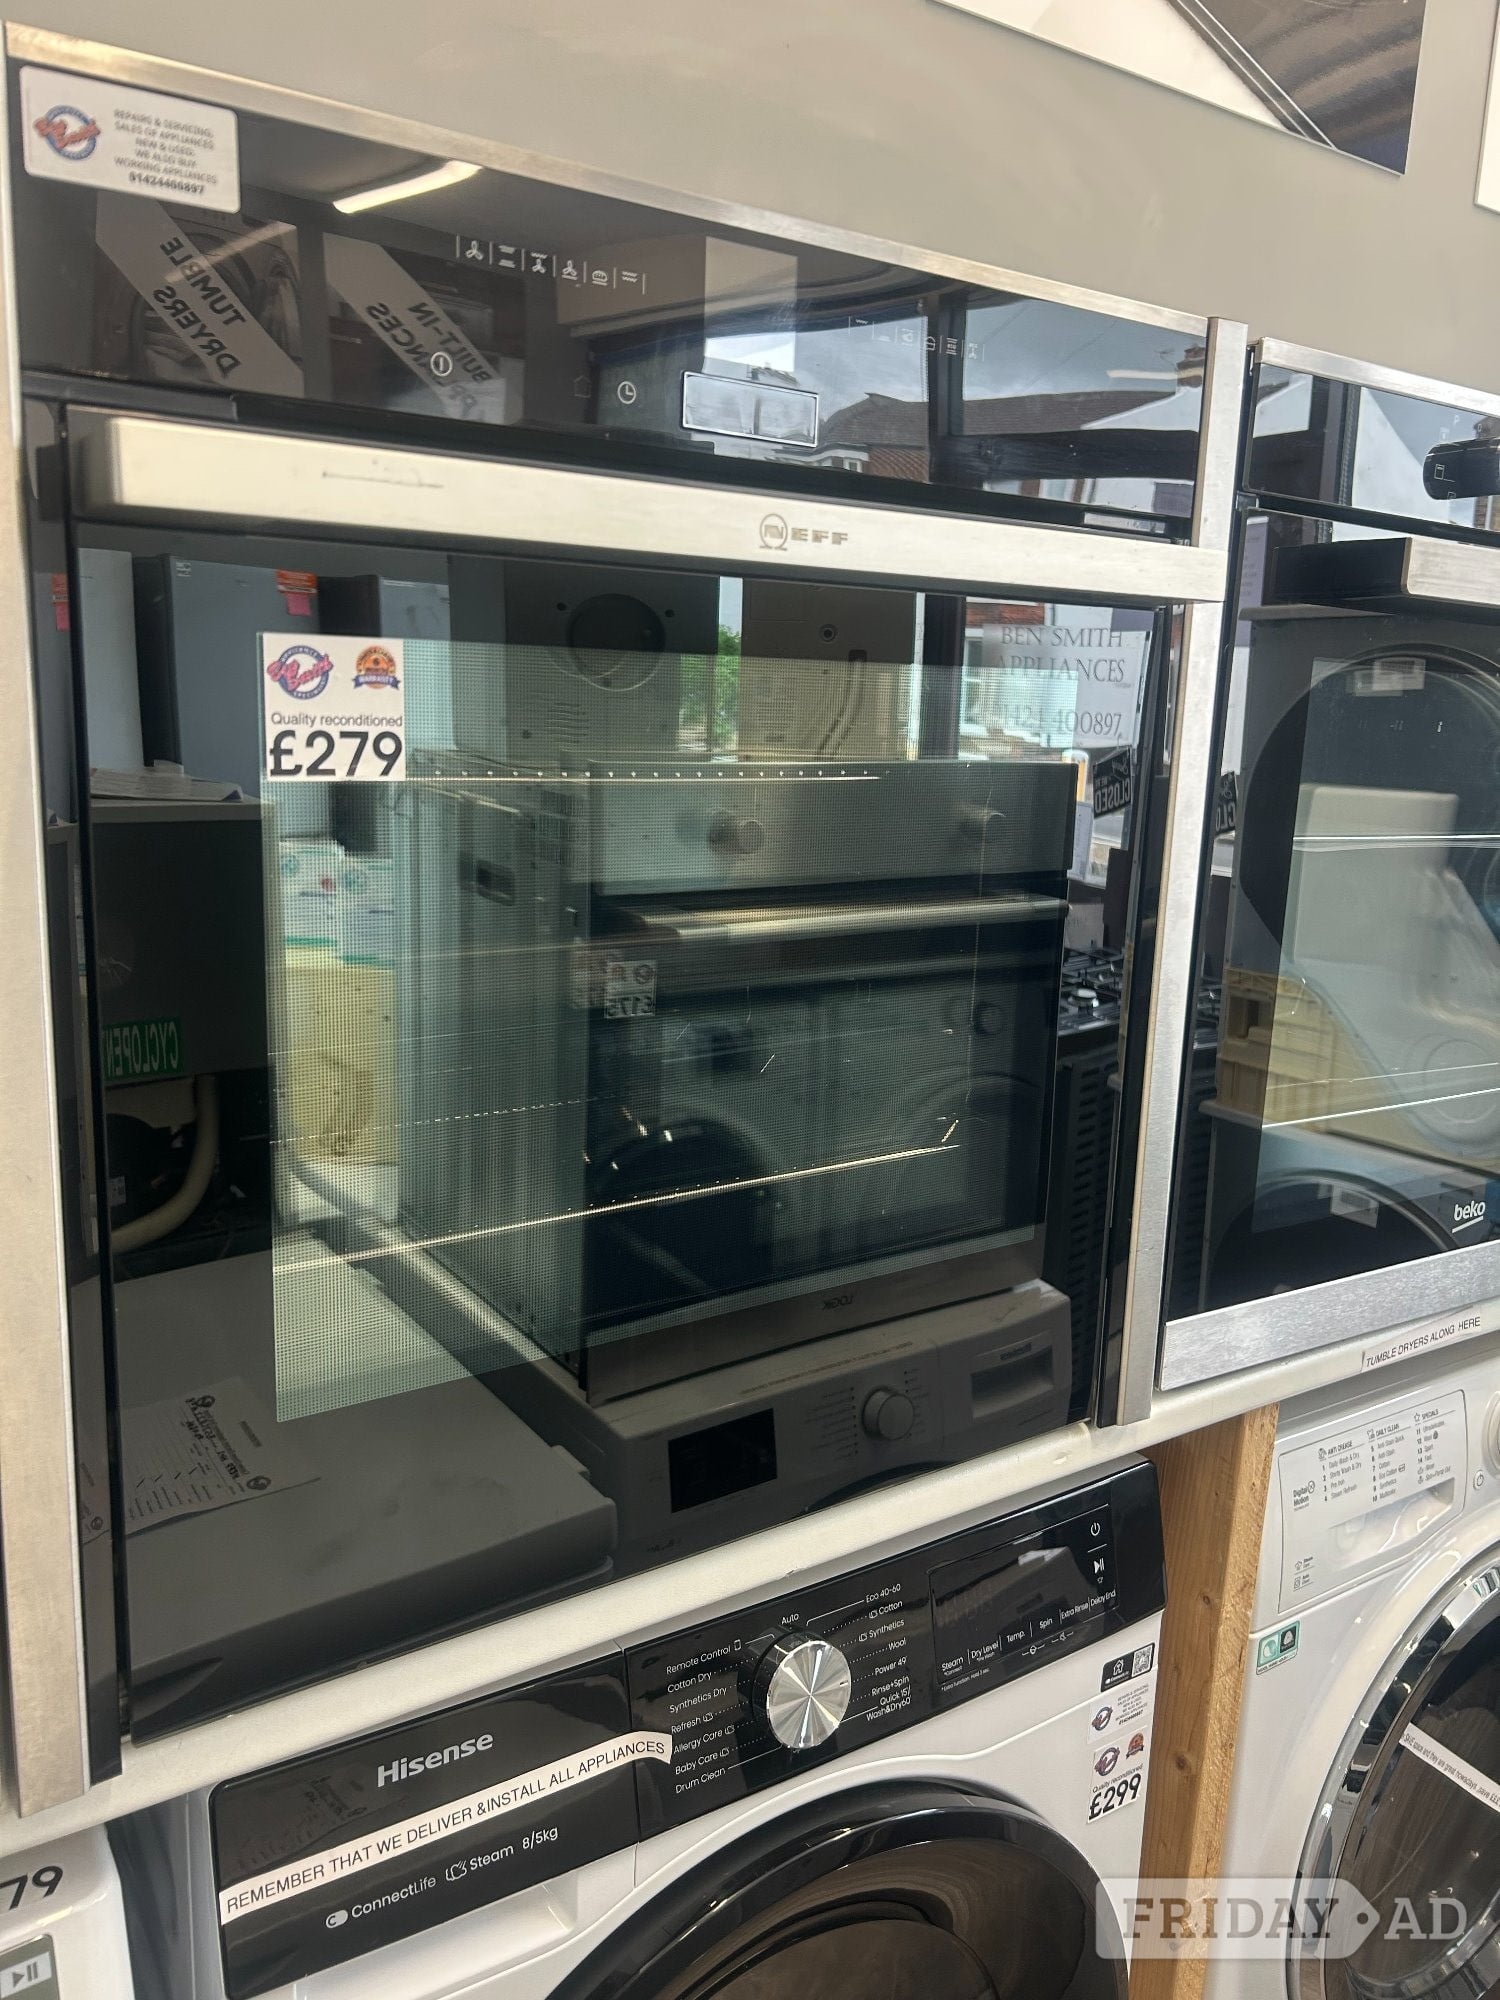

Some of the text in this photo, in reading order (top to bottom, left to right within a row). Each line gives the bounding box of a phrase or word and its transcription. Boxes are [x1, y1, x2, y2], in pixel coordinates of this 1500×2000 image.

[759, 513, 848, 551] NEFF
[1001, 625, 1123, 648] BEN SMITH
[271, 712, 403, 727] Quality reconditioned
[269, 730, 403, 777] £279
[1453, 1199, 1486, 1222] beko
[1366, 1316, 1481, 1368] TUMBLE DRYERS ALONG HERE
[1421, 1408, 1439, 1420] SPECIALS
[1375, 1423, 1400, 1437] DAILY CLEAN
[866, 1583, 901, 1603] Eco 40-60
[781, 1613, 800, 1625] Auto
[878, 1600, 903, 1615] Cotton
[868, 1618, 905, 1639] Synthetics
[941, 1656, 964, 1671] Steam
[971, 1648, 983, 1659] Dry
[982, 1640, 999, 1654] Level
[1039, 1617, 1053, 1629] Spin
[1061, 1608, 1075, 1620] Extra
[1074, 1602, 1089, 1614] Rinse
[1090, 1595, 1105, 1607] Delay
[1105, 1588, 1117, 1600] End
[888, 1637, 907, 1651] Wool
[666, 1645, 731, 1675] Remote Control
[874, 1663, 895, 1676] Power
[667, 1671, 712, 1693] Cotton Dry
[871, 1675, 910, 1697] Rinse+Spin
[669, 1687, 727, 1714] Synthetics Dry
[879, 1692, 900, 1706] Quick
[671, 1716, 701, 1735] Refresh
[673, 1728, 723, 1755] Allergy Care
[377, 1733, 495, 1788] Hisense
[675, 1751, 718, 1775] Baby Care
[1429, 1751, 1439, 1764] they
[1443, 1763, 1457, 1777] great
[1455, 1770, 1478, 1790] nowadays
[675, 1766, 726, 1794] Drum Clean
[1092, 1763, 1144, 1793] Quality reconditioned
[1088, 1773, 1142, 1821] £299
[227, 1864, 325, 1914] REMEMBER
[329, 1846, 372, 1873] THAT
[376, 1833, 403, 1855] WE
[407, 1807, 473, 1844] DELIVER
[549, 1767, 575, 1788] ALL
[578, 1741, 665, 1777] APPLIANCES
[351, 1826, 559, 1919] ConnectLife Steam 8/5kg
